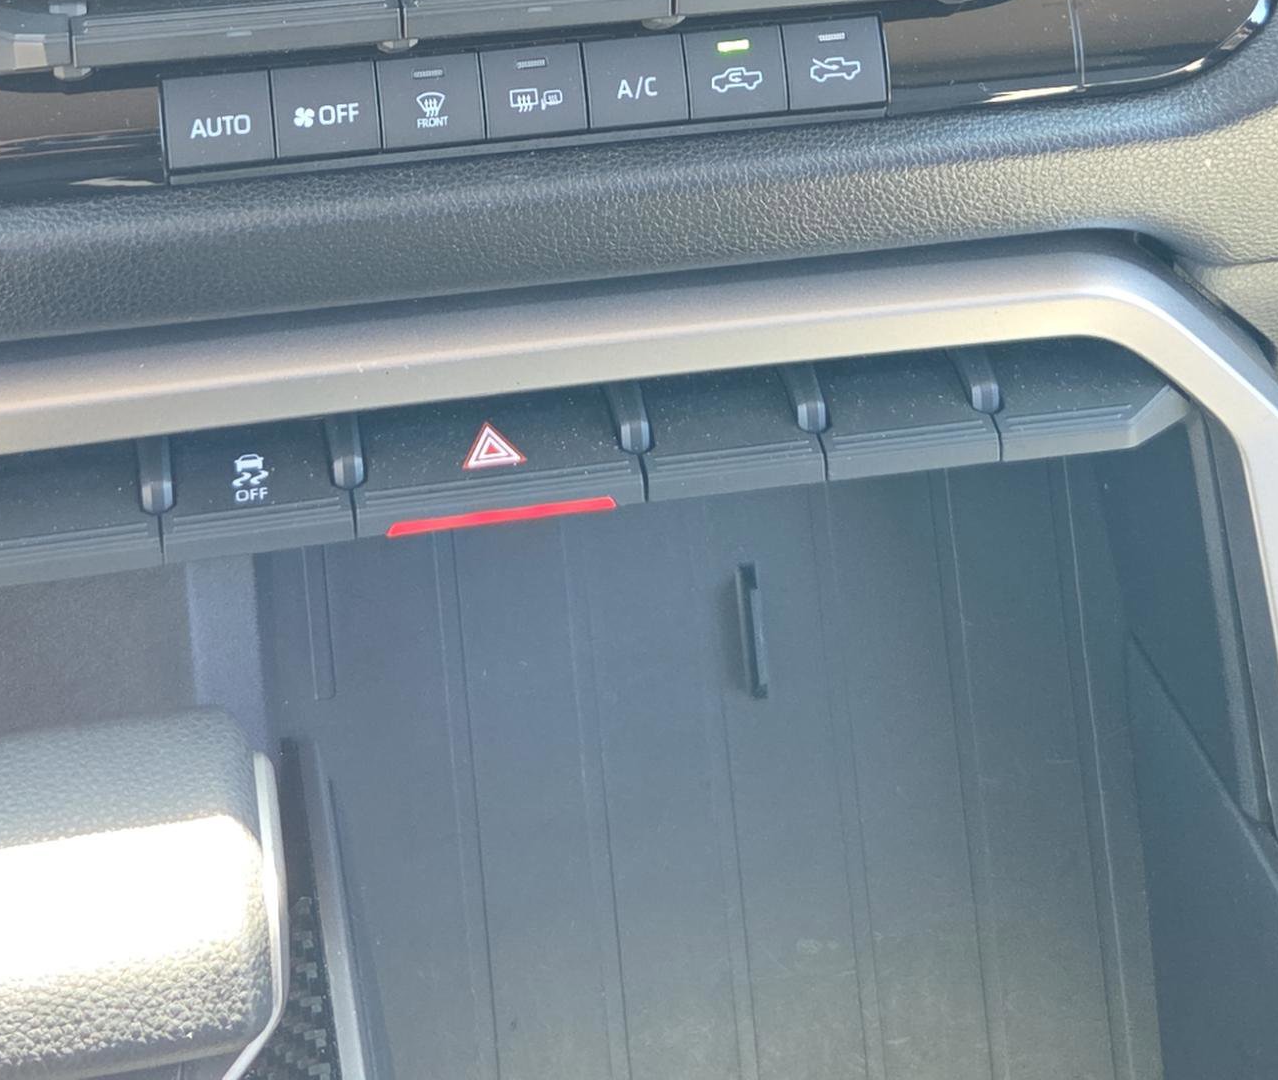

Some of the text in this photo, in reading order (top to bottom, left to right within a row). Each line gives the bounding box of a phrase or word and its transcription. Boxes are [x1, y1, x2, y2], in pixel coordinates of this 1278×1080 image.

[617, 77, 658, 100] A/C
[318, 102, 360, 125] OFF
[417, 115, 448, 128] FRONT
[190, 113, 251, 139] AUTO
[236, 487, 268, 502] OFF
